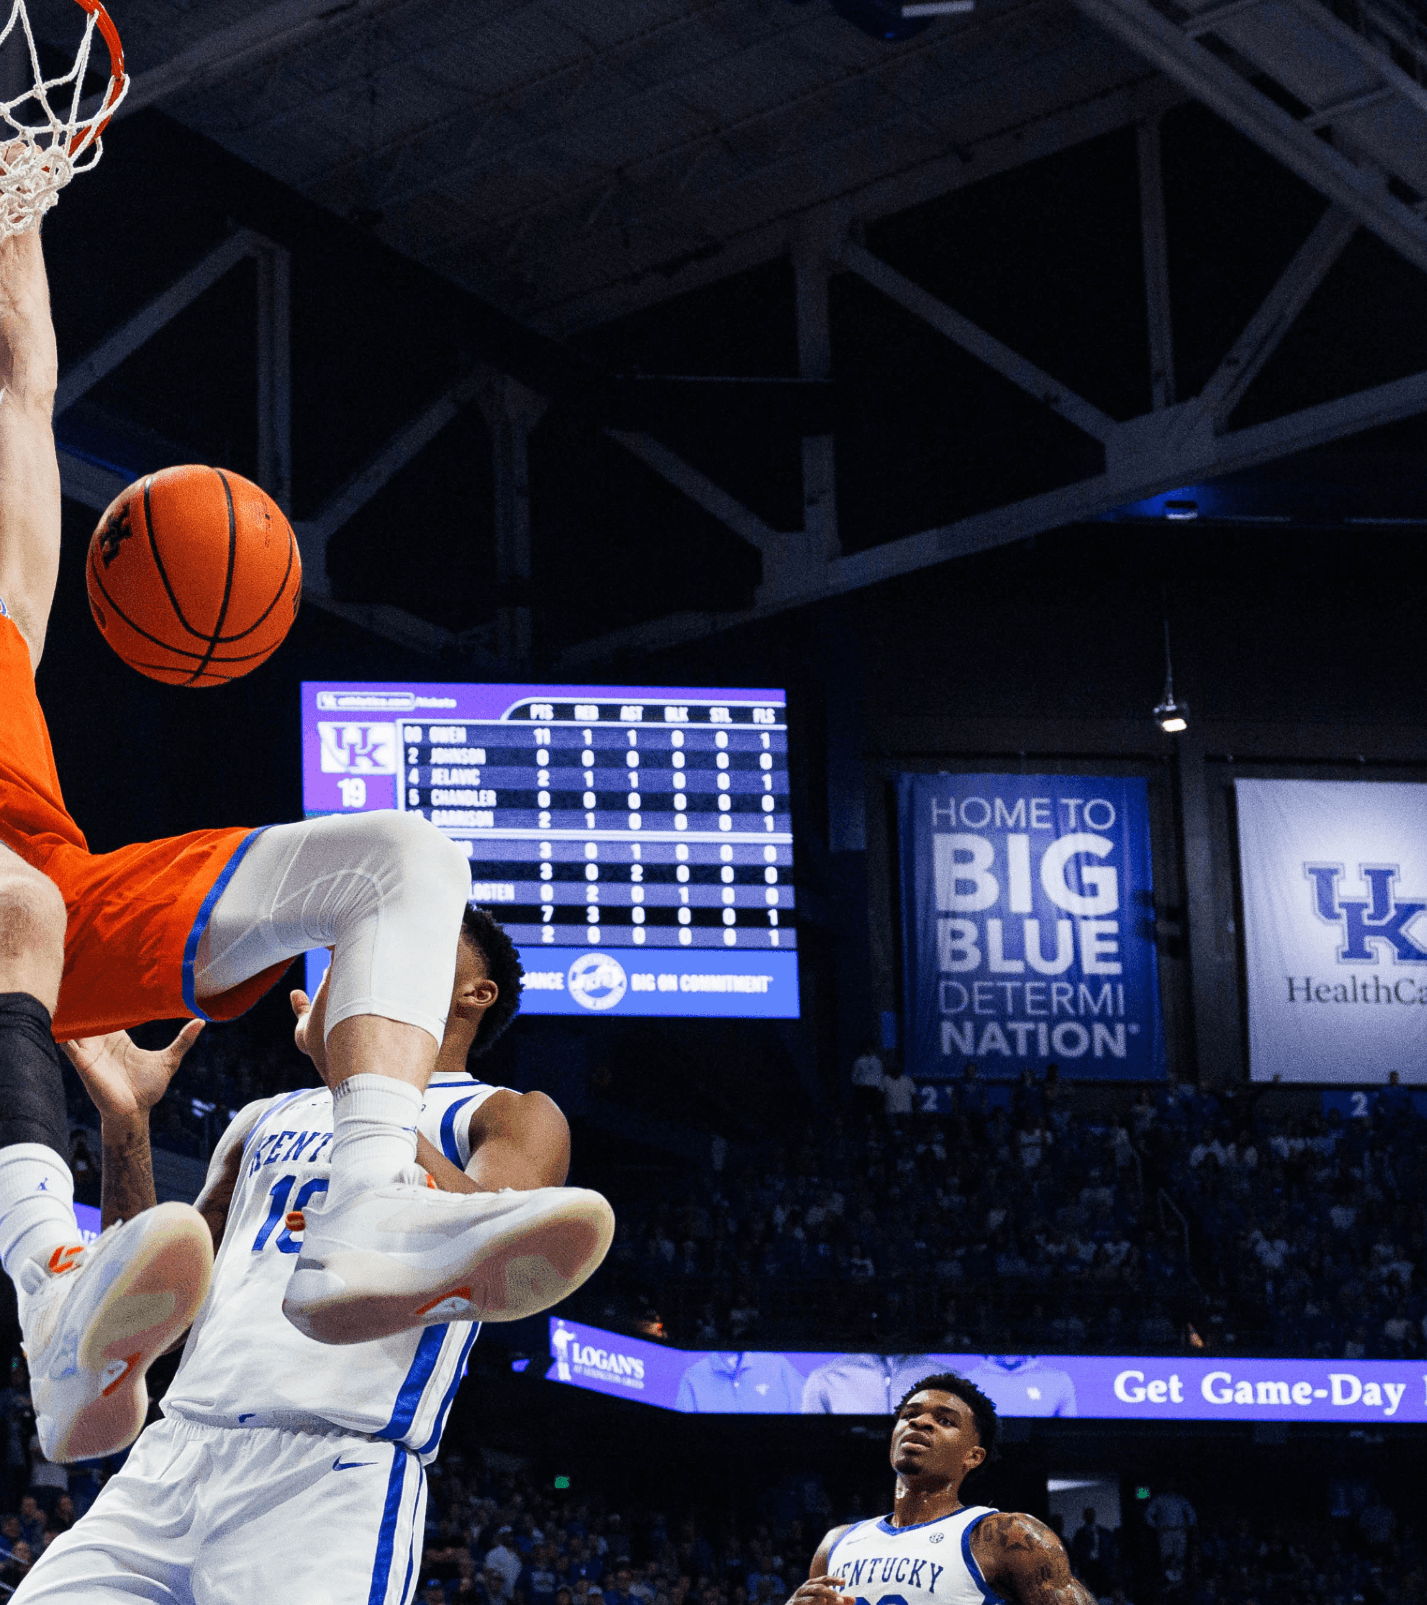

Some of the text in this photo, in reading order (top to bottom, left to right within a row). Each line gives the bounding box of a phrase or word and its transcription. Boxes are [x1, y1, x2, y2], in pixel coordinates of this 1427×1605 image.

[530, 703, 776, 724] PTS REB AST BLK STL FLS
[533, 728, 551, 745] 11
[583, 728, 593, 745] 1
[627, 729, 637, 747] 1
[671, 729, 685, 748] 0
[715, 730, 729, 749] 0
[760, 732, 770, 749] 1
[408, 747, 773, 770] 2 JOHNSON 0 0 0 0 0 0
[408, 767, 419, 784] 4
[537, 769, 550, 787] 2
[583, 770, 594, 787] 1
[628, 771, 639, 788] 1
[673, 771, 686, 789] 0
[717, 772, 730, 790] 0
[762, 773, 772, 791] 1
[337, 777, 366, 808] 19
[409, 788, 775, 812] 5 CHANDLER 0 0 0 0 0 0
[538, 811, 551, 829] 2
[585, 812, 595, 829] 1
[628, 812, 642, 830] 0
[674, 813, 688, 831] 0
[718, 814, 732, 832] 0
[764, 815, 774, 832] 1
[930, 797, 1117, 830] HOME TO
[539, 841, 777, 863] 3 0 1 0 0 0
[540, 862, 778, 884] 3 0 2 0 0 0
[933, 832, 1121, 916] BIG
[540, 883, 554, 902] 0
[586, 884, 599, 903] 2
[630, 885, 645, 904] 0
[678, 886, 689, 904] 1
[721, 886, 736, 905] 0
[765, 887, 779, 906] 0
[541, 905, 778, 926] 7 3 0 0 0 1
[1303, 861, 1427, 966] UK
[541, 925, 779, 947] 2 0 0 0 0 1
[936, 918, 1123, 976] BLUE
[631, 973, 656, 992] BIG
[657, 973, 679, 992] ON
[938, 980, 1125, 1017] DETERMI
[249, 1130, 334, 1178] KENT
[1113, 1370, 1184, 1404] Get
[1200, 1371, 1407, 1416] Game-Day
